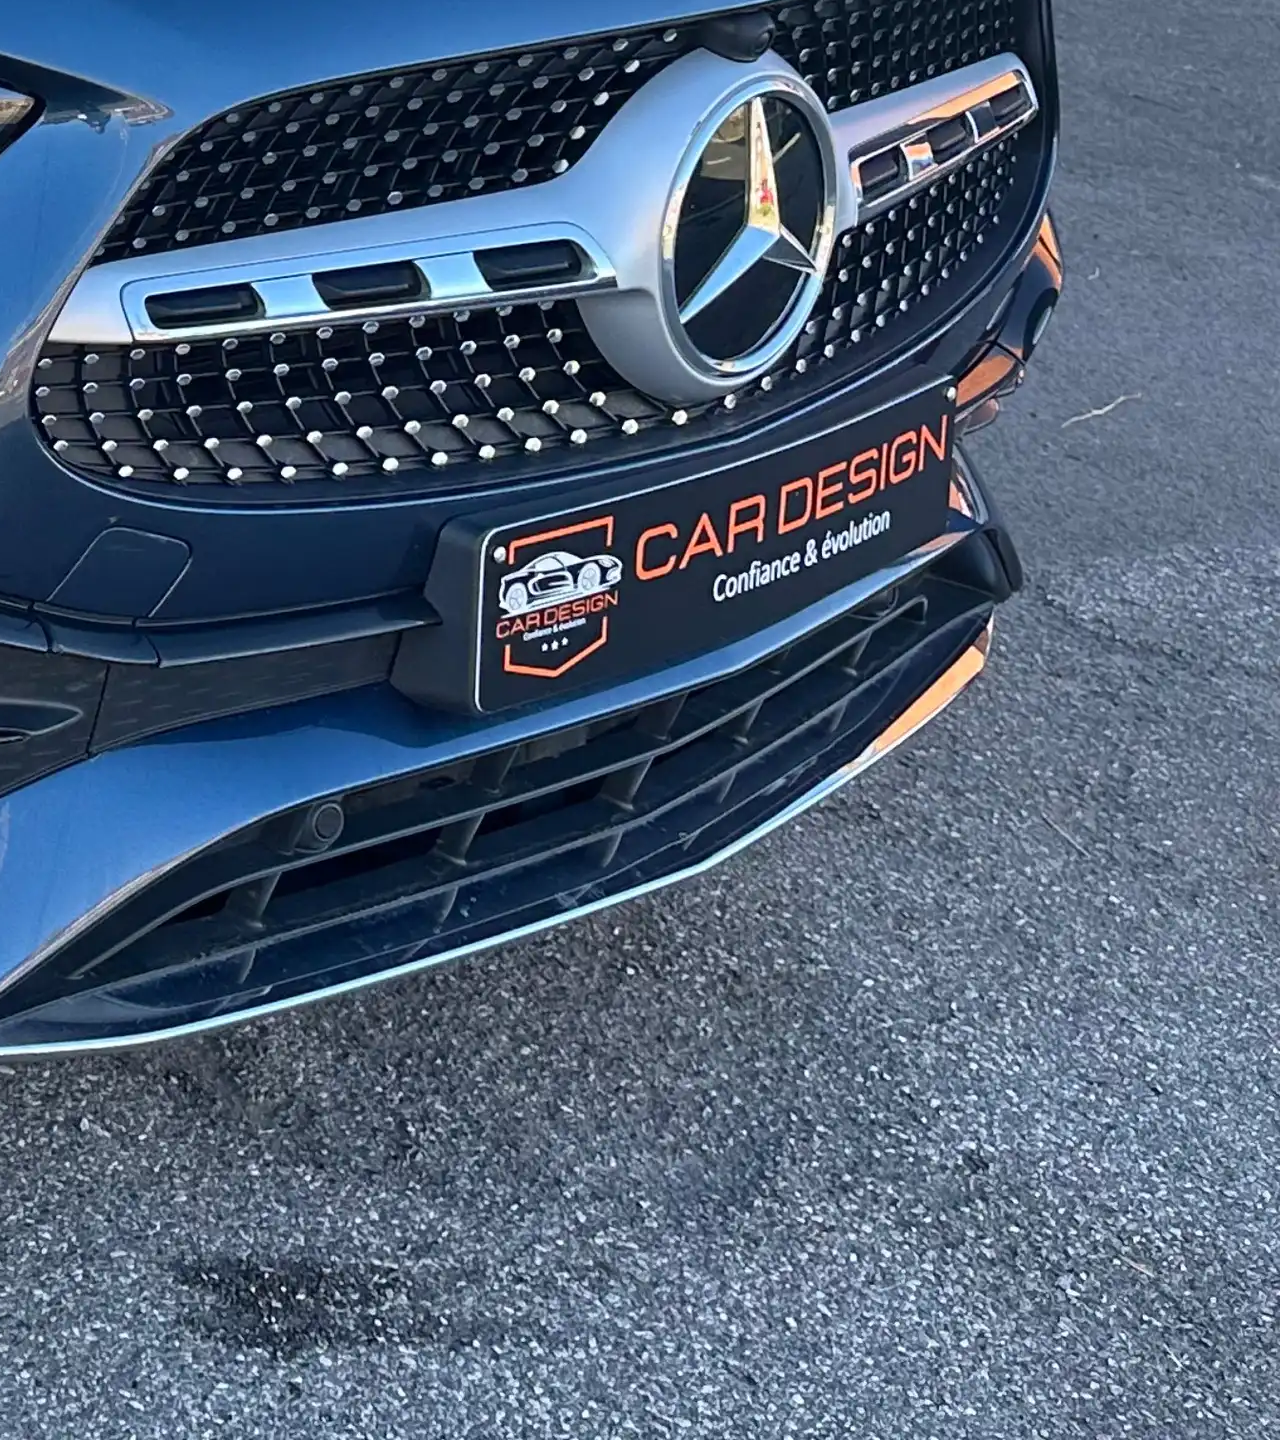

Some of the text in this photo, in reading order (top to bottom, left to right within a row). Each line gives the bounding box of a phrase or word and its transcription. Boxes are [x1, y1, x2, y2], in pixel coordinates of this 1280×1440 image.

[634, 413, 949, 581] CAR DESIGN
[712, 509, 891, 602] Confiance & évolution
[495, 616, 541, 639] CAR
[542, 590, 619, 627] DESIGN
